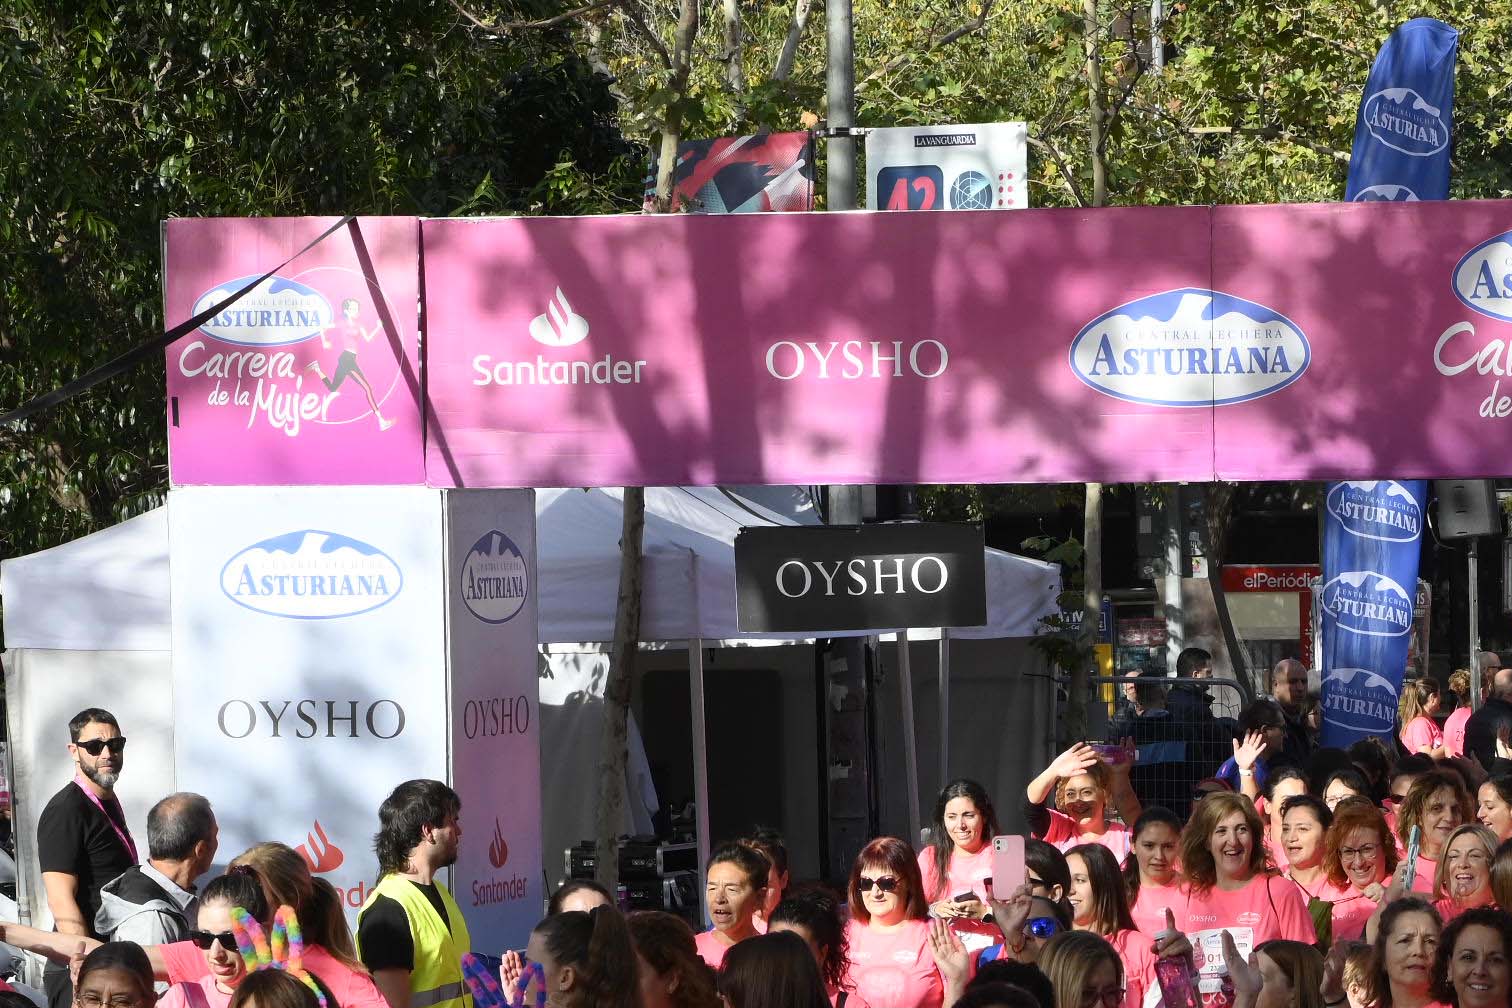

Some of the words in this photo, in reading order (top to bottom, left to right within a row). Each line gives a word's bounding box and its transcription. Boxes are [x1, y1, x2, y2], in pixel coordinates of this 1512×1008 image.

[1125, 329, 1200, 341] CENTRAL
[1209, 328, 1283, 340] LECHERA
[179, 341, 295, 378] Carrera
[473, 353, 646, 385] Santander
[765, 339, 949, 379] OYSHO
[1089, 333, 1292, 376] ASTURIANA
[208, 379, 230, 406] de
[234, 379, 250, 406] la
[248, 375, 341, 437] Mujer
[1479, 379, 1512, 418] de
[1336, 490, 1417, 534] ASTURIANA
[234, 563, 390, 596] ASTURIANA
[466, 566, 524, 601] ASTURIANA
[775, 556, 949, 597] OYSHO
[1243, 572, 1313, 588] elPeriódi
[1329, 586, 1408, 628] ASTURIANA
[217, 699, 406, 739] OYSHO
[463, 695, 530, 739] OYSHO
[472, 872, 527, 907] Santander
